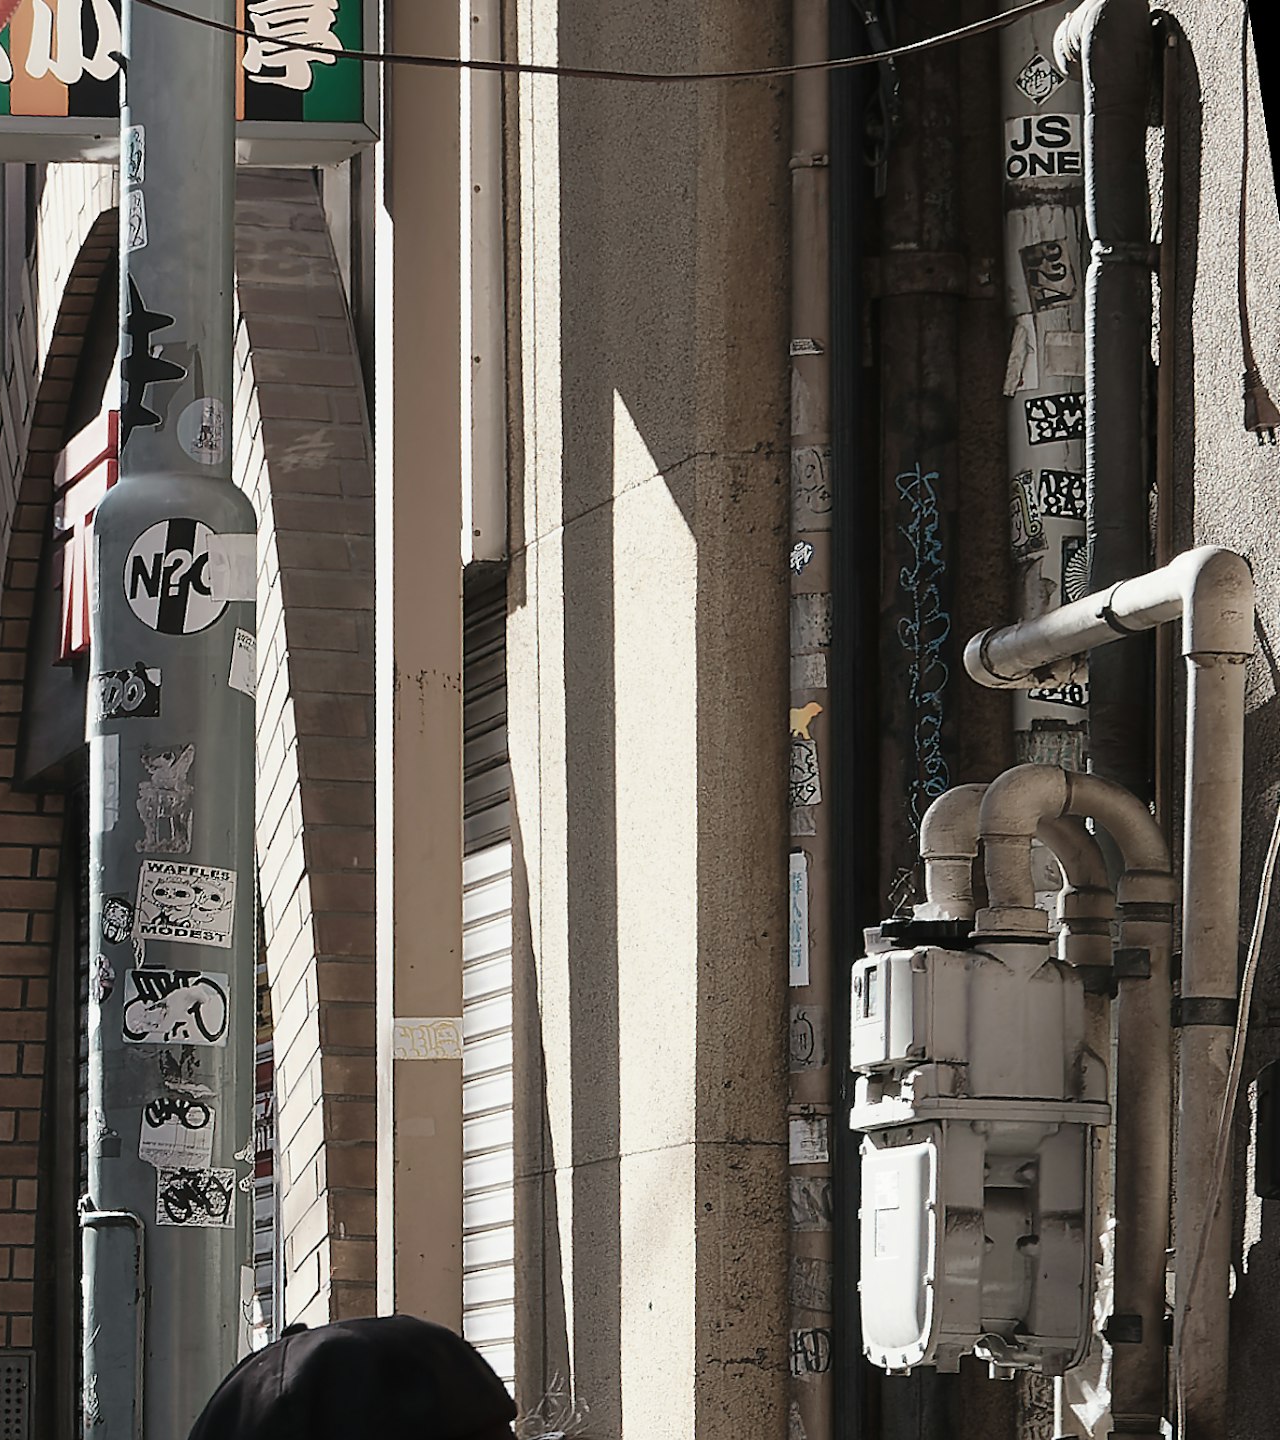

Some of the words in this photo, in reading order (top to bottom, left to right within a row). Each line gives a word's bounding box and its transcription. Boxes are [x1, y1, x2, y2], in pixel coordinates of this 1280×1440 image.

[1010, 115, 1071, 152] JS
[1006, 152, 1080, 178] ONE
[147, 862, 231, 881] WAFFLES
[140, 925, 228, 942] MODEST
